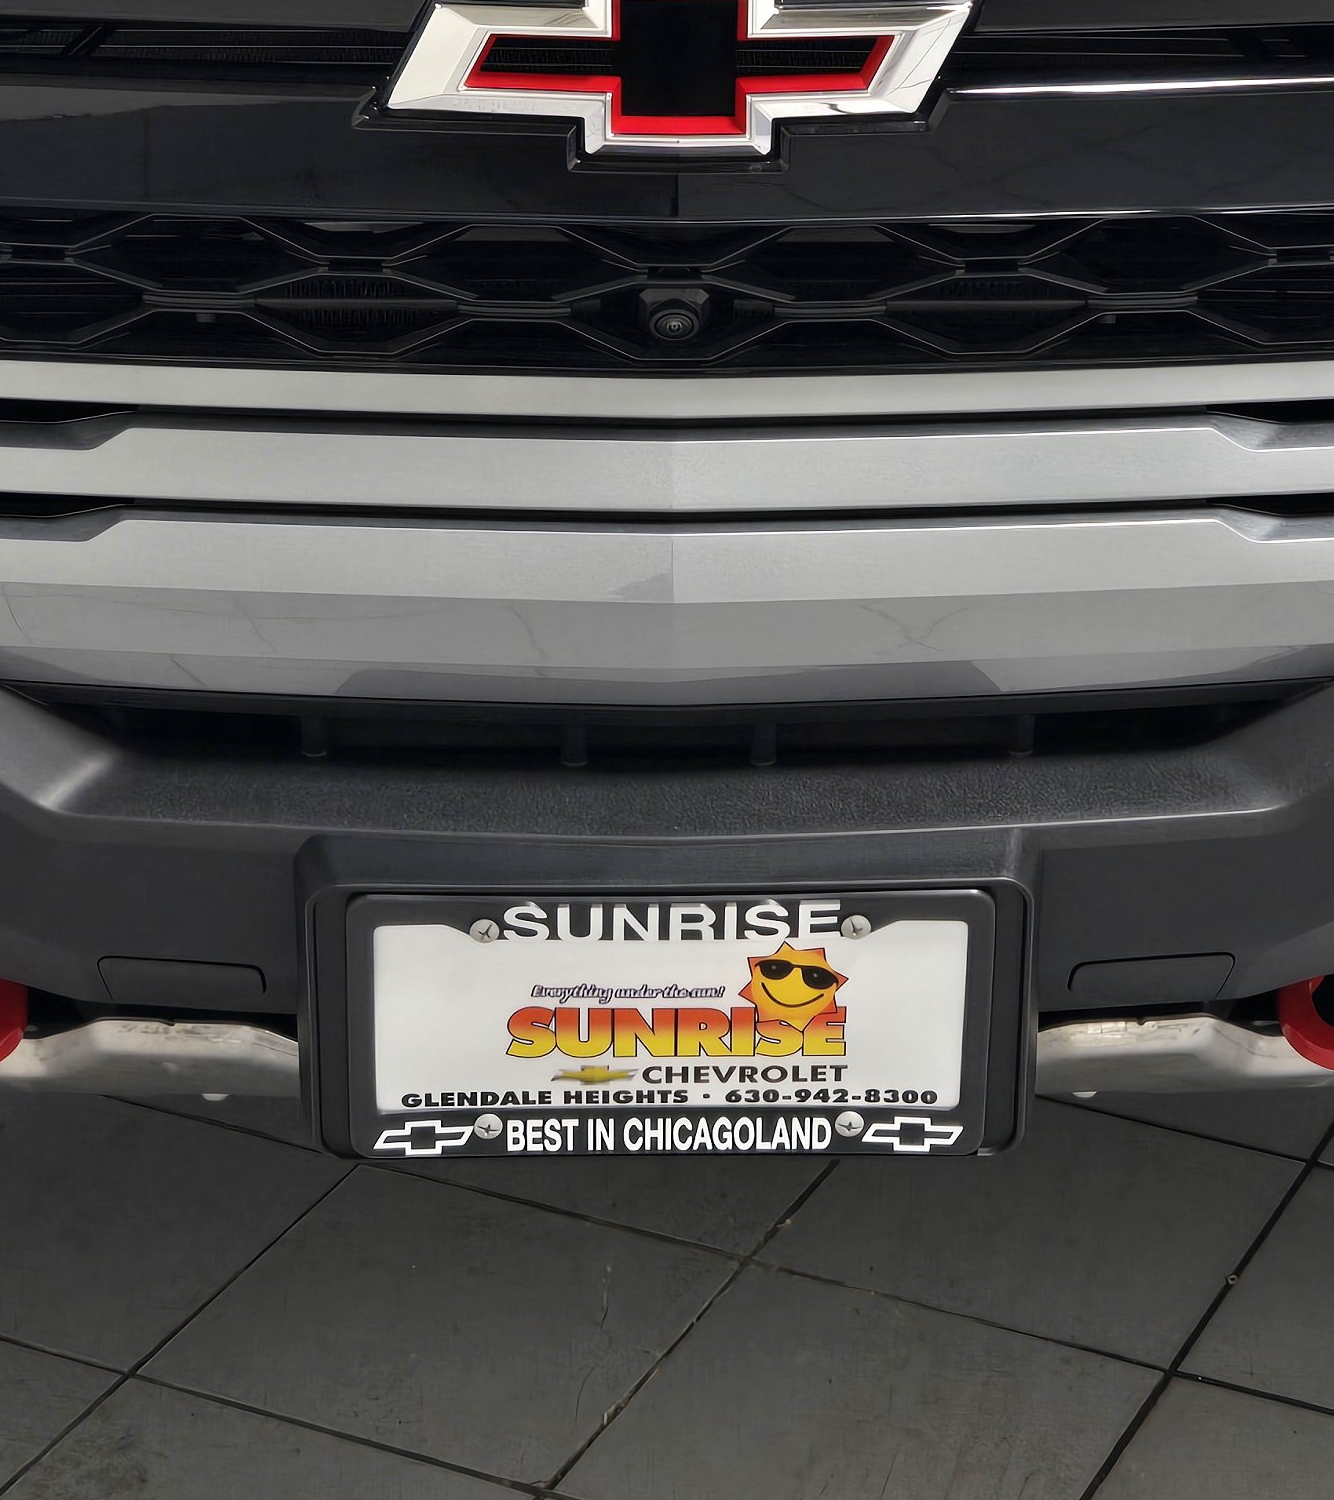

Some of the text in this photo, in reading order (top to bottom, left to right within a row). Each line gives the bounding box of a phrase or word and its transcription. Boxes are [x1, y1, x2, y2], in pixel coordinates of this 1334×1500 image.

[502, 899, 841, 942] SUNRISE
[530, 983, 613, 1004] Everything
[506, 1006, 847, 1058] SUNRISE
[641, 1064, 848, 1084] CHEVROLET
[401, 1088, 938, 1108] GLENDALE HEIGHTS 630-942-8300
[506, 1116, 832, 1152] BEST IN CHICAGOLAND
